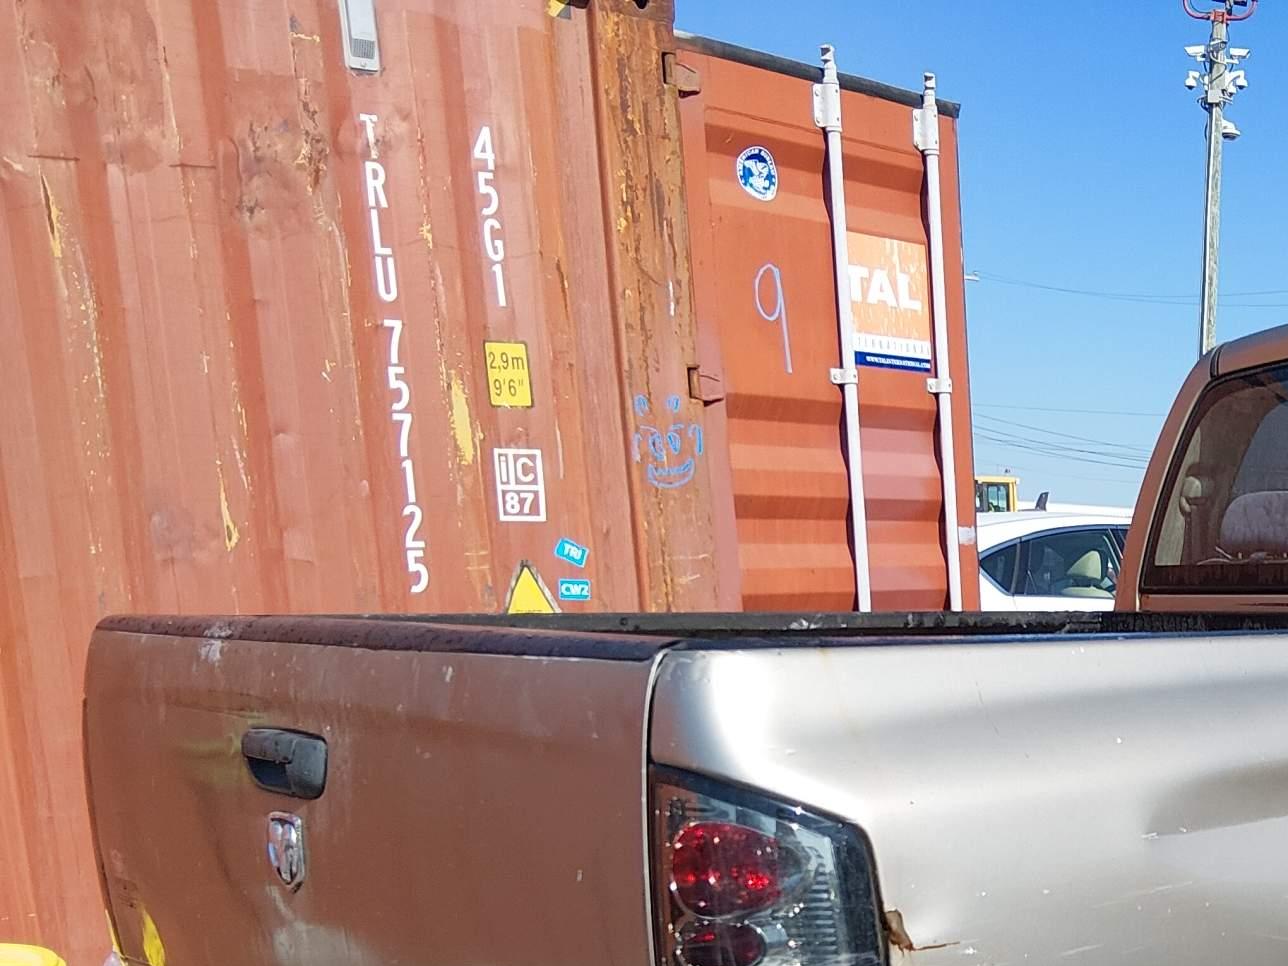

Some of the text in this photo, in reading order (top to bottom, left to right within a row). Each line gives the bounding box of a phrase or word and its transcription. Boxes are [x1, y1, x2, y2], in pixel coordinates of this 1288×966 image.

[474, 126, 507, 307] 45G1
[848, 264, 922, 311] TAL
[359, 113, 430, 593] TRLU 757125
[505, 492, 535, 514] 87
